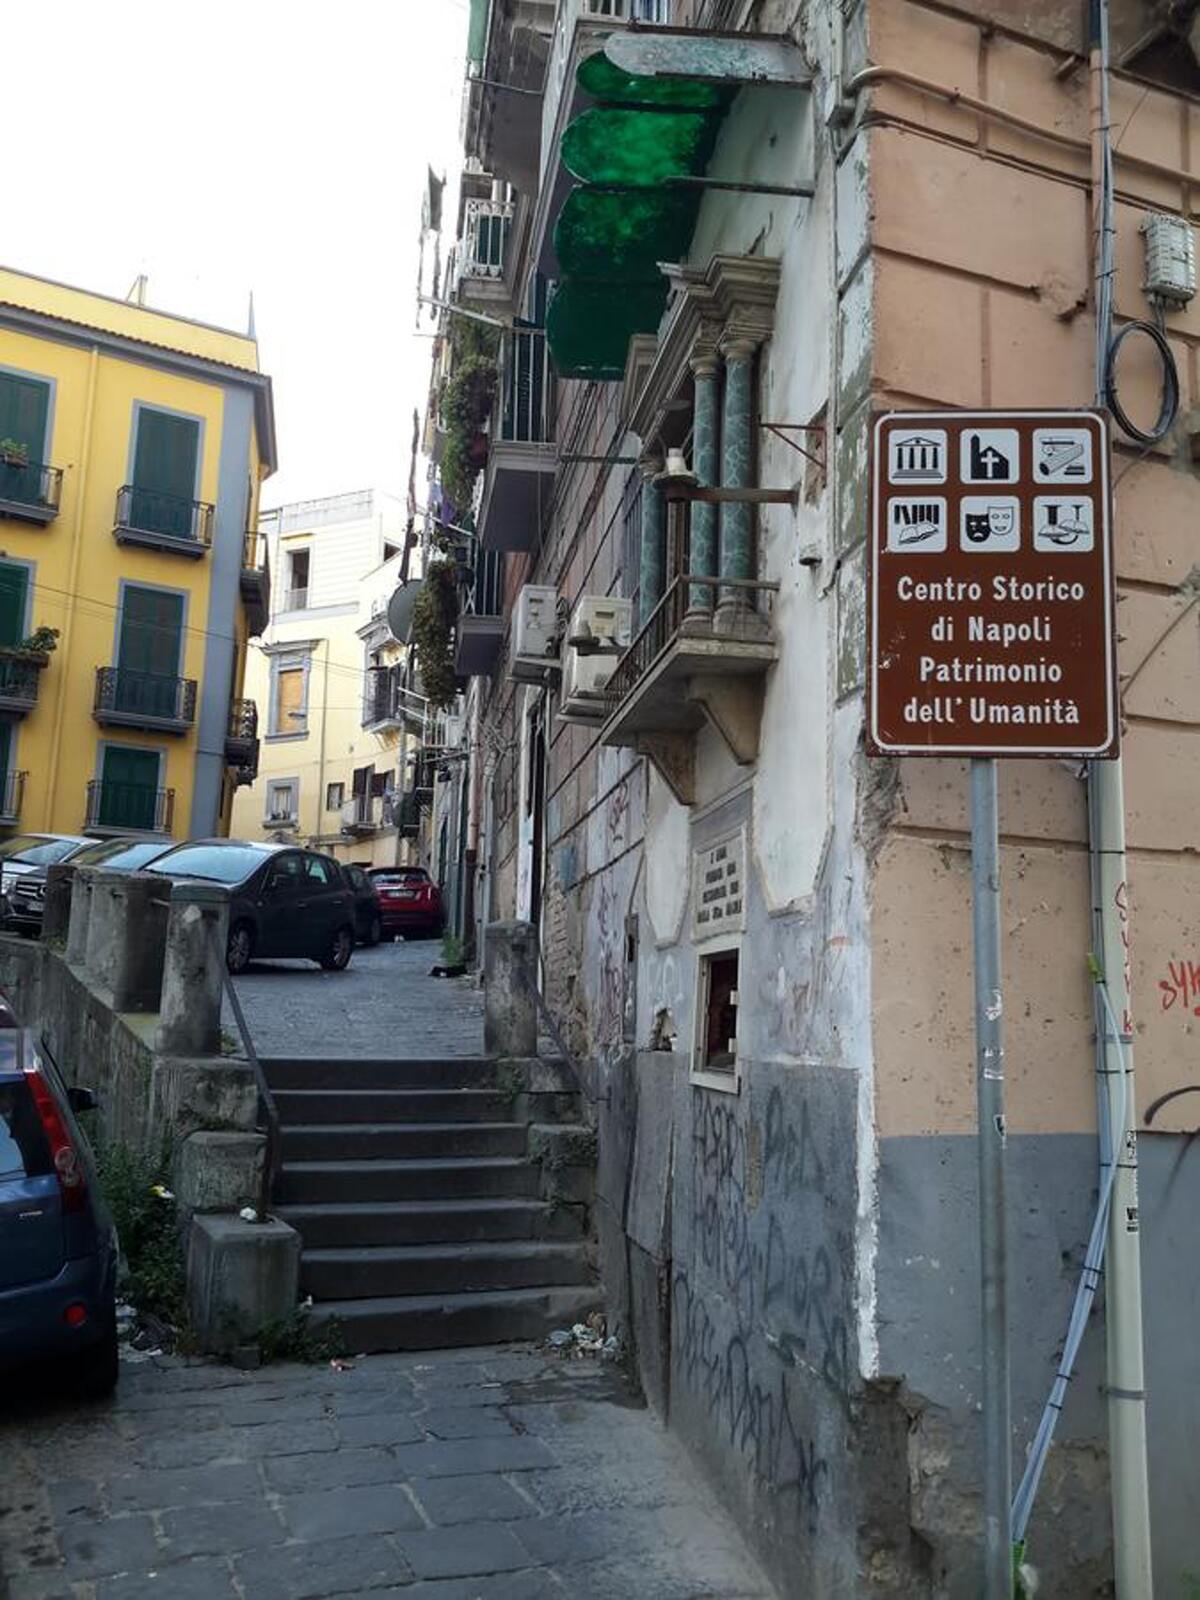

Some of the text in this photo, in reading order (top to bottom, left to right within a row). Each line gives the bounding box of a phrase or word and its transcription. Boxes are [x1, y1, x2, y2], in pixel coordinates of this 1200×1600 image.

[897, 575, 1084, 601] Centro Storico
[931, 616, 1050, 647] di Napoli
[920, 656, 1062, 682] Patrimonio
